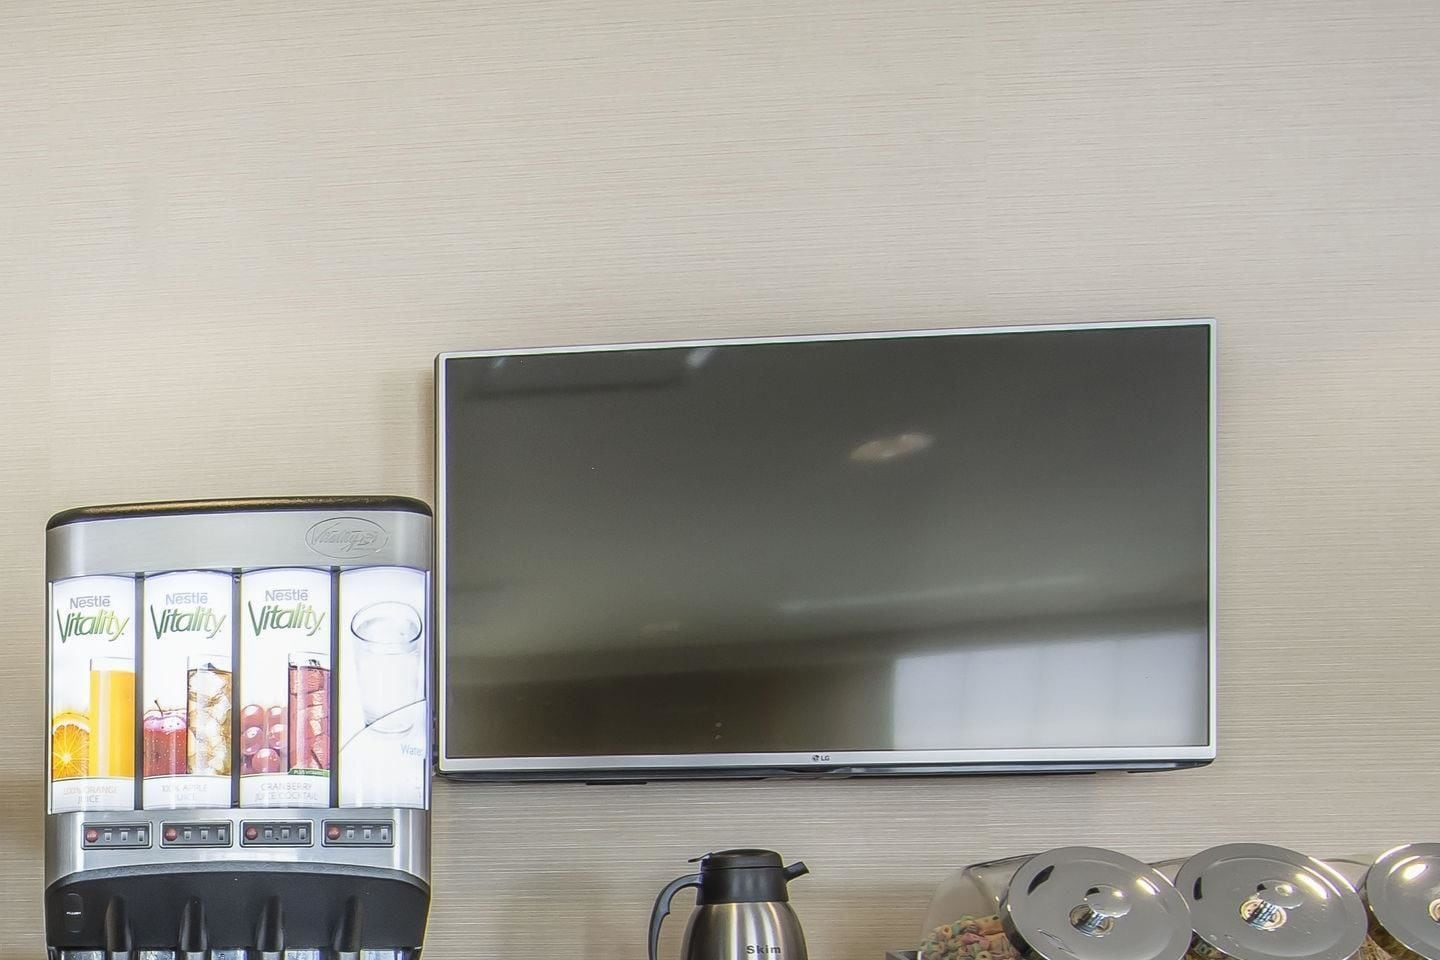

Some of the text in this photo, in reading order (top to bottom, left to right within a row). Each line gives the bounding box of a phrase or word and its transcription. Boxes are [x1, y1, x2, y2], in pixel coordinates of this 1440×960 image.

[56, 608, 130, 643] Vitality
[150, 604, 227, 639] Vitality
[247, 600, 326, 637] Vitality
[746, 945, 781, 954] Skim
